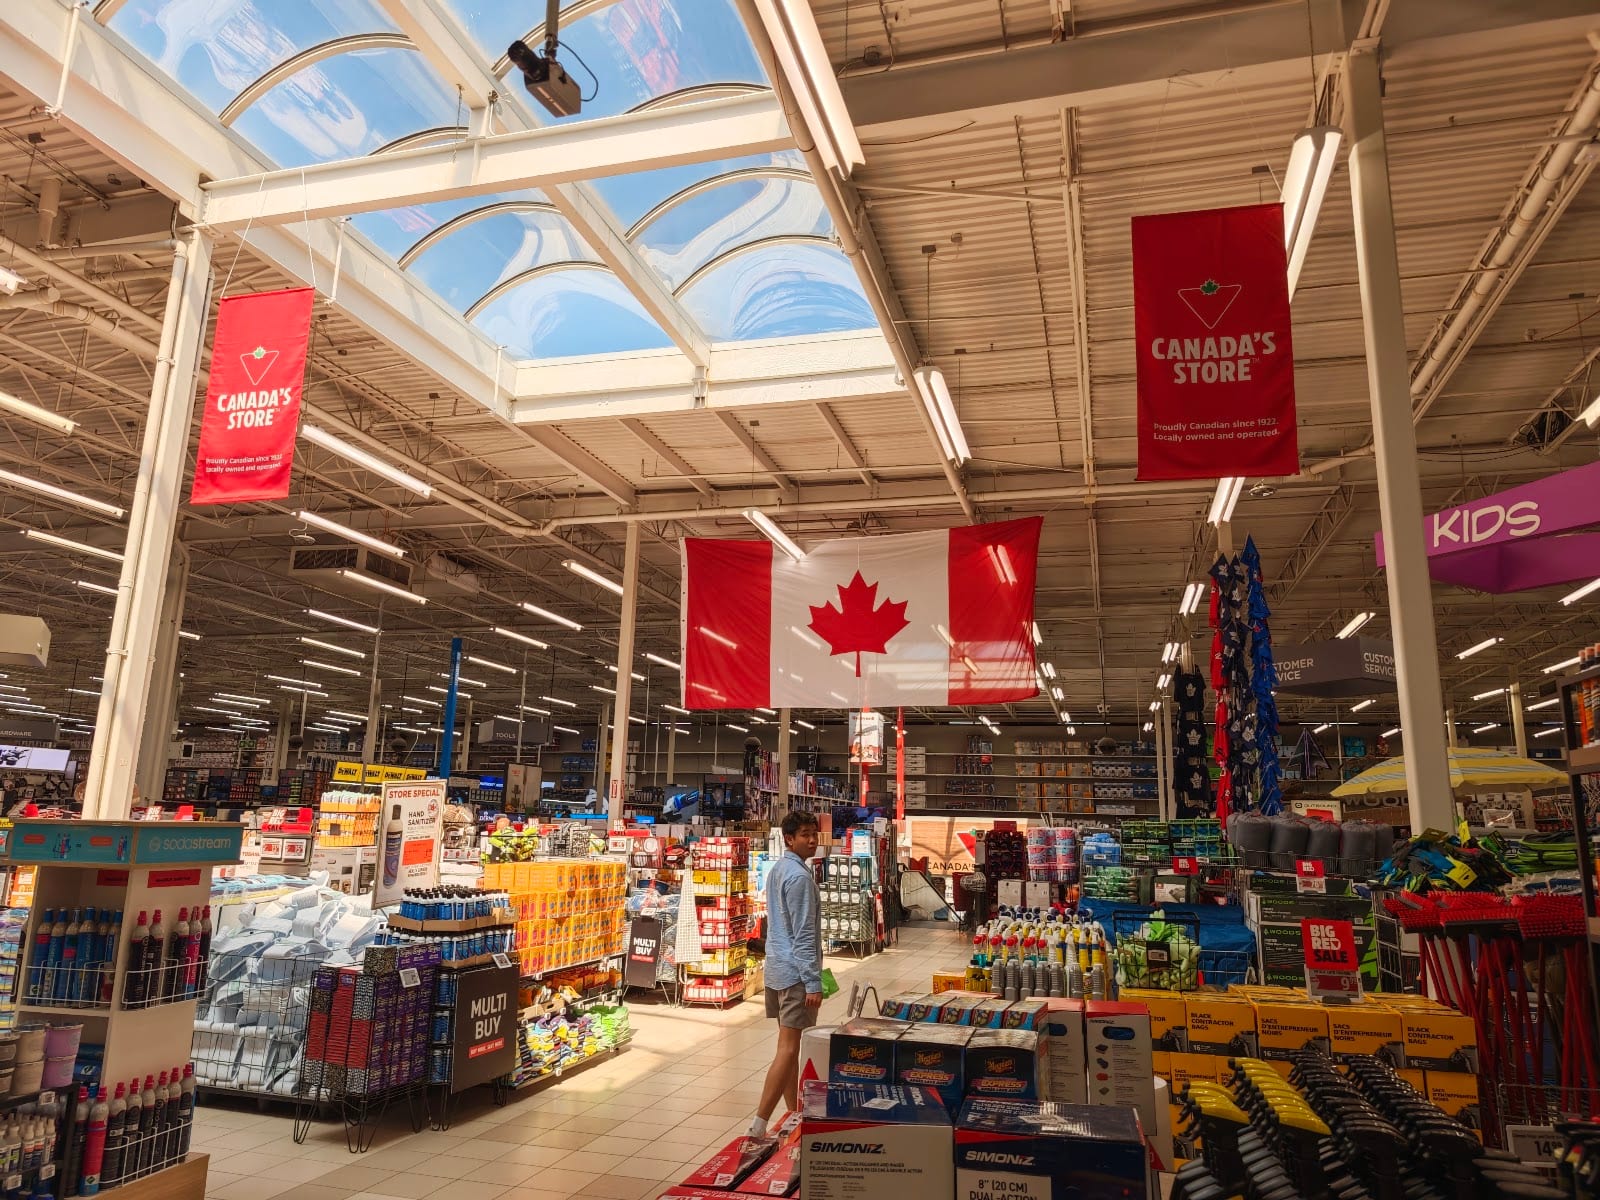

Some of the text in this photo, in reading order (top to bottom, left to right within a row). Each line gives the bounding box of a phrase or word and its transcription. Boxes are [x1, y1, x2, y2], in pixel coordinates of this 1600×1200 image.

[1151, 331, 1277, 360] CANADA'S
[1173, 358, 1252, 384] STORE
[217, 387, 292, 413] CANADA'S
[227, 408, 275, 430] STORE
[1153, 418, 1280, 432] Proudly Canadian since 1922.
[1153, 428, 1281, 443] Locally owned and operated.
[1433, 500, 1541, 548] KIDS
[388, 788, 440, 799] STORE SPECIAL
[271, 808, 285, 817] BIG
[407, 817, 436, 826] SANITIZER
[163, 836, 231, 850] sodastream
[1309, 924, 1336, 938] BIG
[633, 937, 657, 948] MULTI
[1311, 936, 1341, 951] RED
[635, 946, 653, 956] BUY
[1313, 949, 1348, 963] SALE
[470, 992, 507, 1019] MULTI
[474, 1014, 502, 1040] BUY
[1191, 1018, 1234, 1027] CONTRACTOR
[1261, 1023, 1319, 1033] D'ENTREPRENEUR
[1333, 1029, 1392, 1038] D'ENTREPRENEUR
[1407, 1032, 1454, 1041] CONTRACTOR
[1193, 1044, 1201, 1052] 16
[842, 1065, 882, 1075] EXPRESS
[909, 1072, 950, 1081] EXPRESS
[981, 1079, 1023, 1088] EXPRESS
[992, 1180, 1007, 1191] (20
[1009, 1182, 1028, 1193] CM)
[969, 1191, 1038, 1200] DUAL-ACTION
